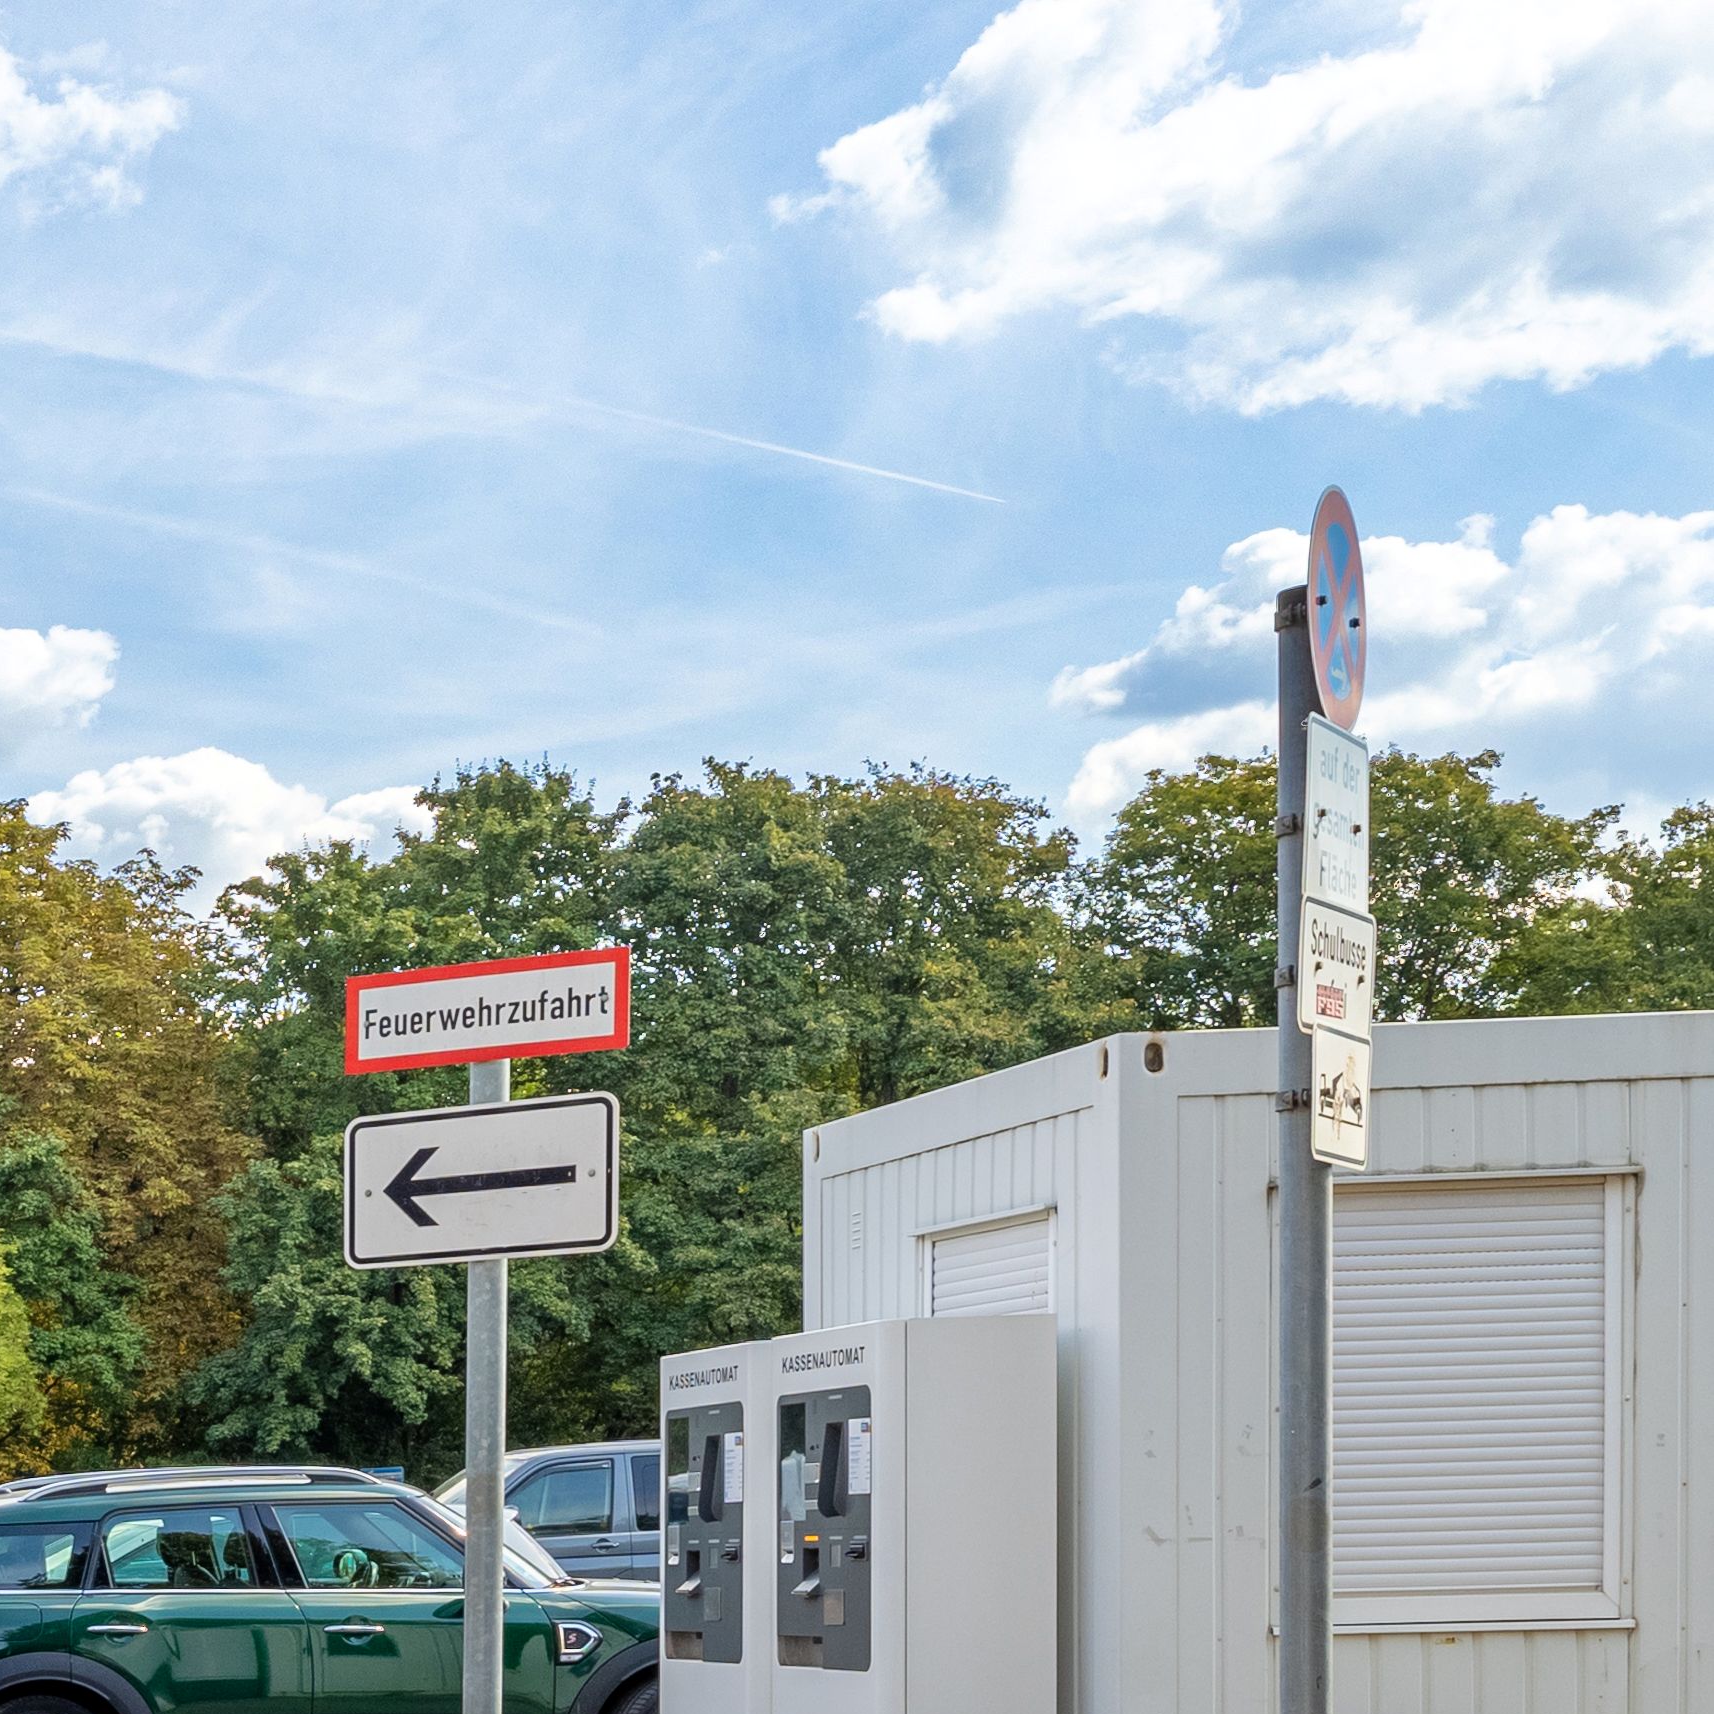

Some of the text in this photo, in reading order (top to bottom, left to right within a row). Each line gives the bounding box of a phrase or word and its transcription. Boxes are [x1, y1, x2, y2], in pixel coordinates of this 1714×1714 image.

[1320, 747, 1361, 795] auf der
[1313, 801, 1365, 851] gesamten
[1319, 849, 1358, 901] Fläche
[1310, 918, 1367, 972] Schulbusse
[364, 985, 610, 1040] Feuerwehrzufahrt
[668, 1365, 739, 1391] KASSENAUTOMAT
[781, 1346, 866, 1374] KASSENAUTOMAT
